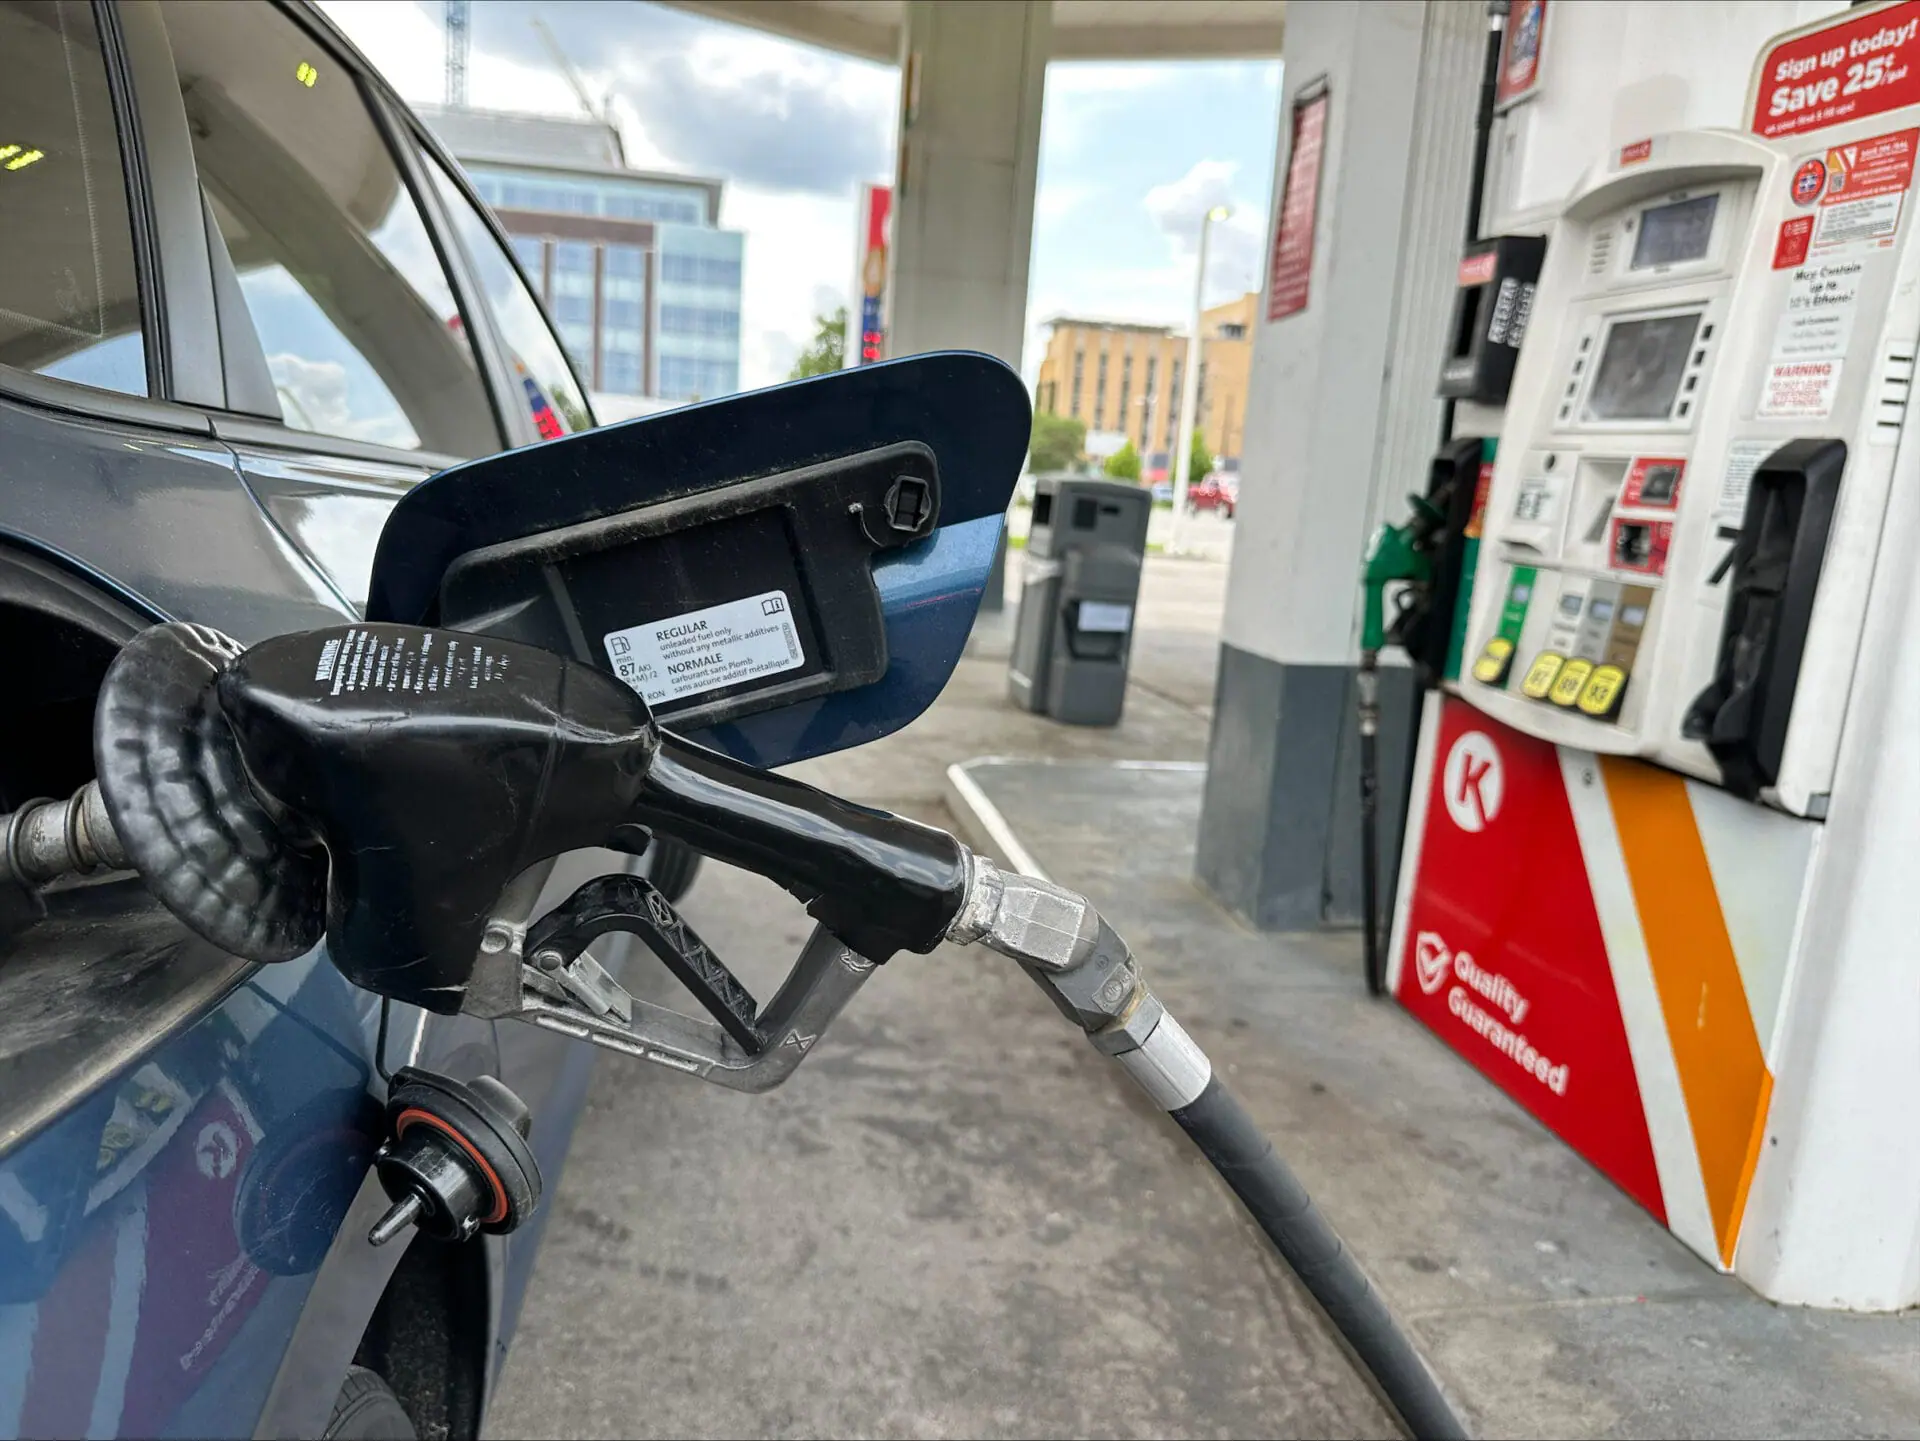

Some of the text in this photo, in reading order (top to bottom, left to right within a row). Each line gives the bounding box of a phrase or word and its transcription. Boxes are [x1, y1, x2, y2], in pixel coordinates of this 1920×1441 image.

[1775, 18, 1918, 82] Sign up today!
[1768, 76, 1839, 117] Save
[1775, 363, 1832, 376] WARNING
[656, 620, 708, 641] REGULAR
[660, 627, 732, 650] unleaded fuel only
[663, 625, 780, 659] without any metallic additives
[315, 640, 339, 681] WARNING
[620, 662, 635, 677] 87
[667, 653, 723, 675] NORMALE
[671, 658, 753, 684] carburant sans Plomb
[674, 658, 790, 693] sans aucune additif métallique
[647, 690, 666, 699] RON
[1454, 744, 1494, 828] K
[1454, 951, 1531, 1025] Quality
[1447, 986, 1571, 1097] Guaranteed
